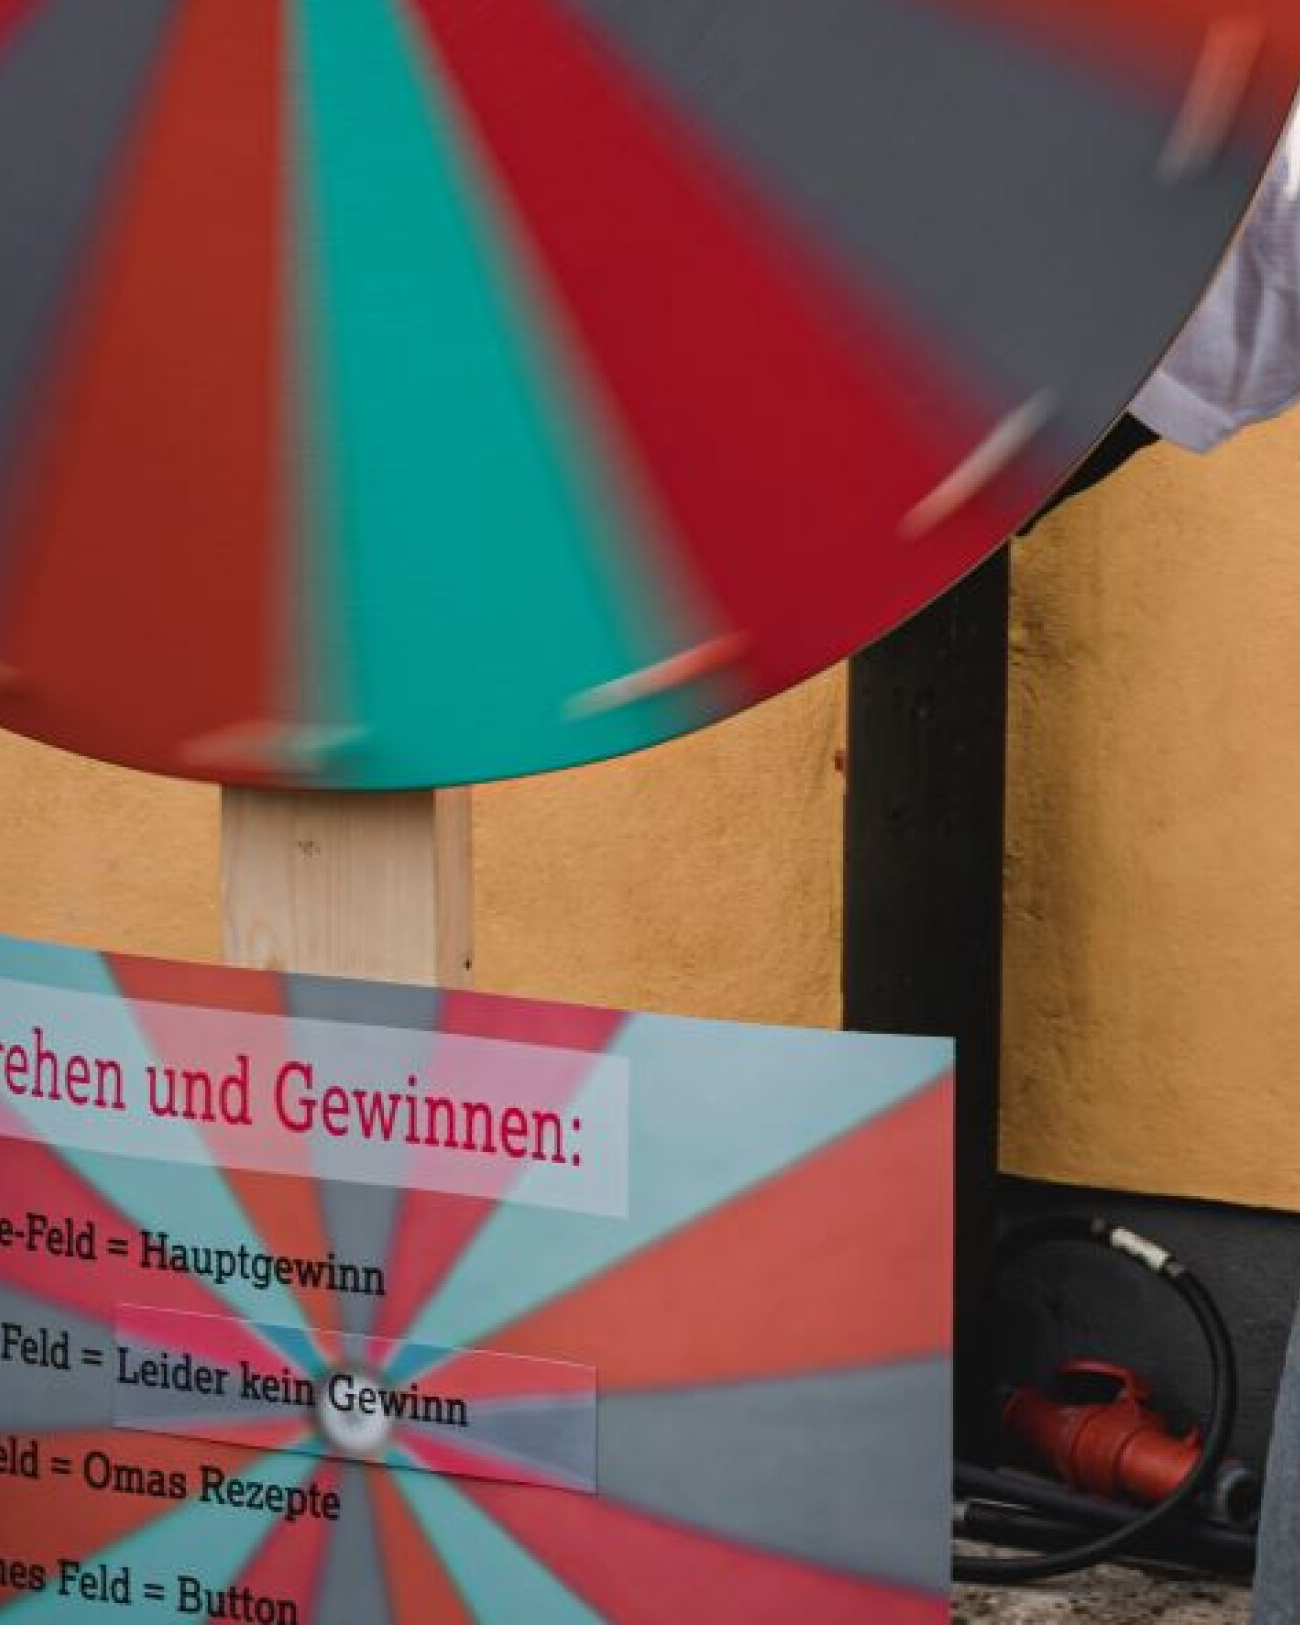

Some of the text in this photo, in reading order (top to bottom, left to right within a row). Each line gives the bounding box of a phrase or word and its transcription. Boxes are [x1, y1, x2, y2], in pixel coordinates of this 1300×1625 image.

[145, 1053, 253, 1126] und
[274, 1060, 581, 1167] Gewinnen:
[106, 1238, 130, 1256] =
[139, 1229, 387, 1297] Hauptgewinn
[0, 1321, 71, 1371] Feld
[81, 1347, 104, 1366] =
[116, 1346, 230, 1396] Leider
[238, 1360, 317, 1408] kein
[328, 1373, 470, 1427] Gewinn
[50, 1455, 73, 1475] =
[83, 1450, 187, 1500] Omas
[199, 1464, 342, 1522] Rezepte
[56, 1557, 132, 1605] Feld
[143, 1582, 165, 1601] =
[176, 1574, 300, 1625] Button
